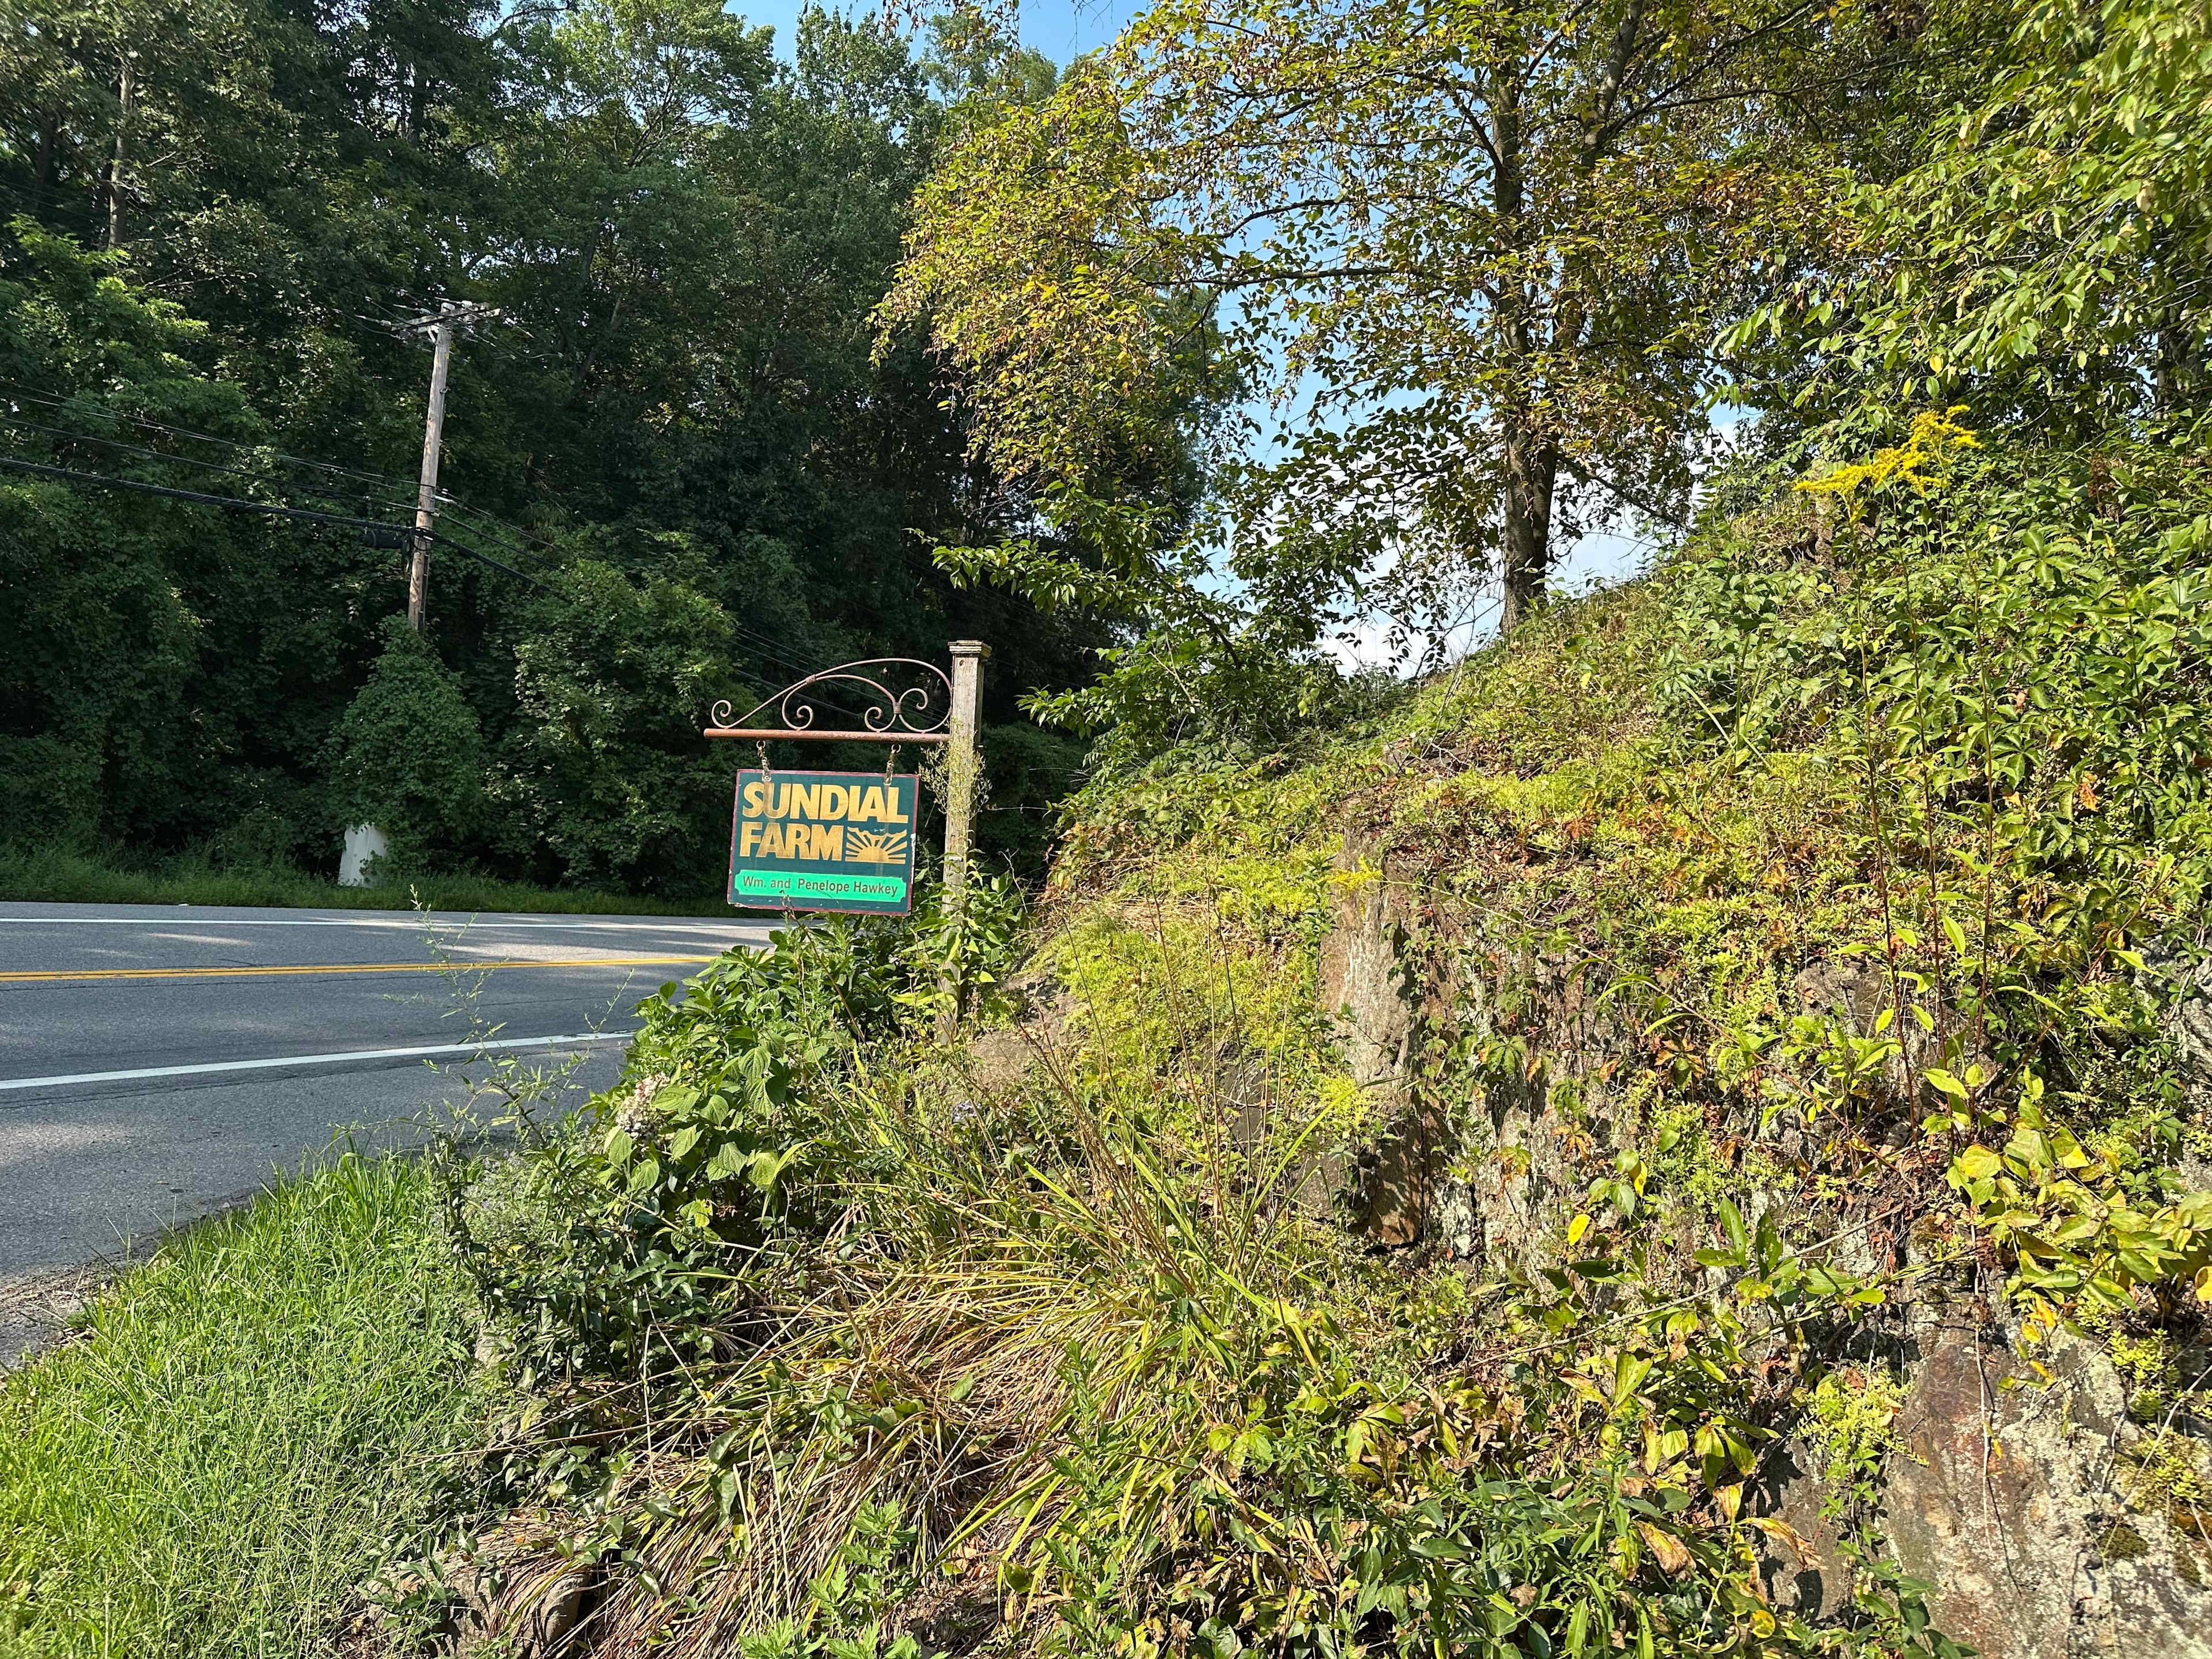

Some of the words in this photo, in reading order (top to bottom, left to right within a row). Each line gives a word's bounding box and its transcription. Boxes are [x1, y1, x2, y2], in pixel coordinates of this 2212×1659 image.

[743, 782, 908, 823] SUNDIAL
[740, 821, 844, 861] FARM
[743, 876, 766, 888] Wm.
[770, 876, 790, 889] and
[798, 879, 850, 894] Penelope
[854, 881, 898, 897] Hawkey
